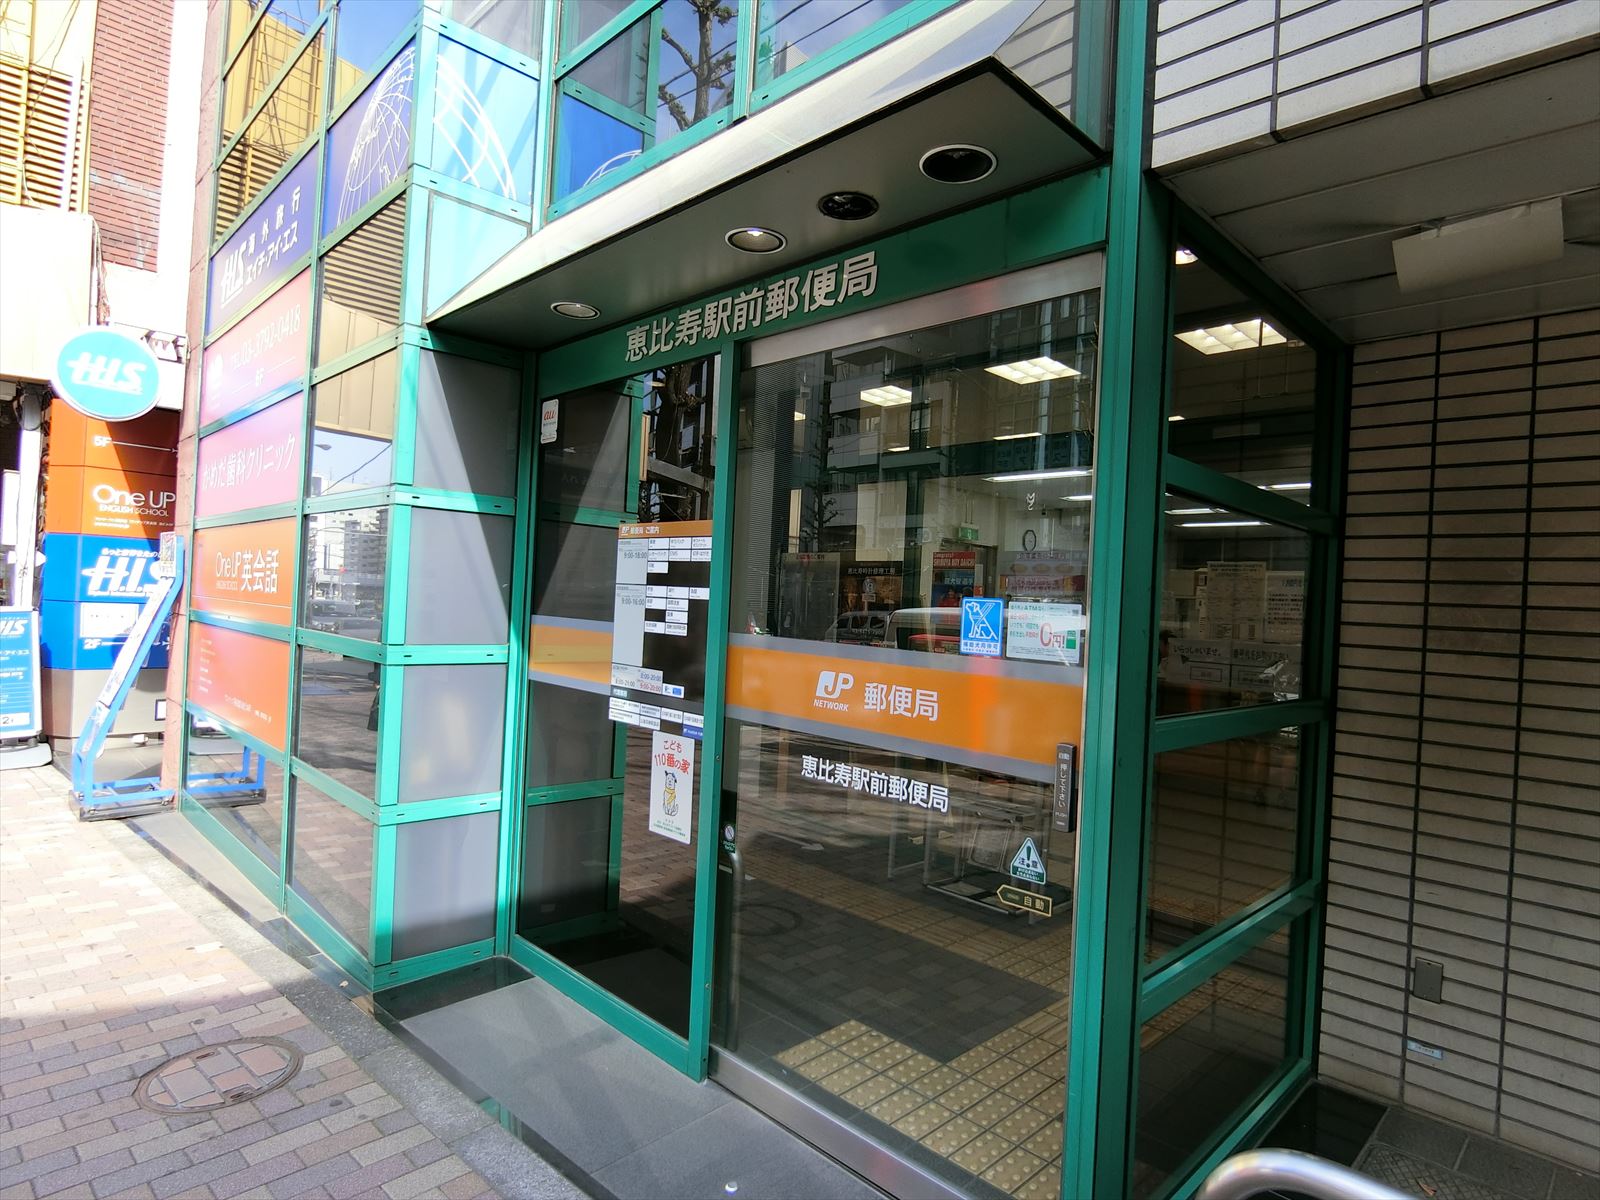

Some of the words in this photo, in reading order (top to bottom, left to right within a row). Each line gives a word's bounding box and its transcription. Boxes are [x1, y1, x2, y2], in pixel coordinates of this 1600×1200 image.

[624, 250, 878, 362] 恵比寿駅前郵便局
[201, 432, 296, 490] かめだ歯科クリニック
[92, 484, 145, 506] One
[149, 490, 176, 508] UP
[134, 507, 168, 516] SCHOOL
[241, 548, 279, 593] 英会話
[813, 698, 849, 712] NETWORK
[863, 681, 940, 721] 郵便局
[664, 740, 682, 753] こども
[654, 753, 691, 774] 110番の家
[801, 754, 949, 813] 恵比寿駅前郵便局
[1018, 857, 1039, 869] 注意
[1024, 895, 1044, 911] 自動
